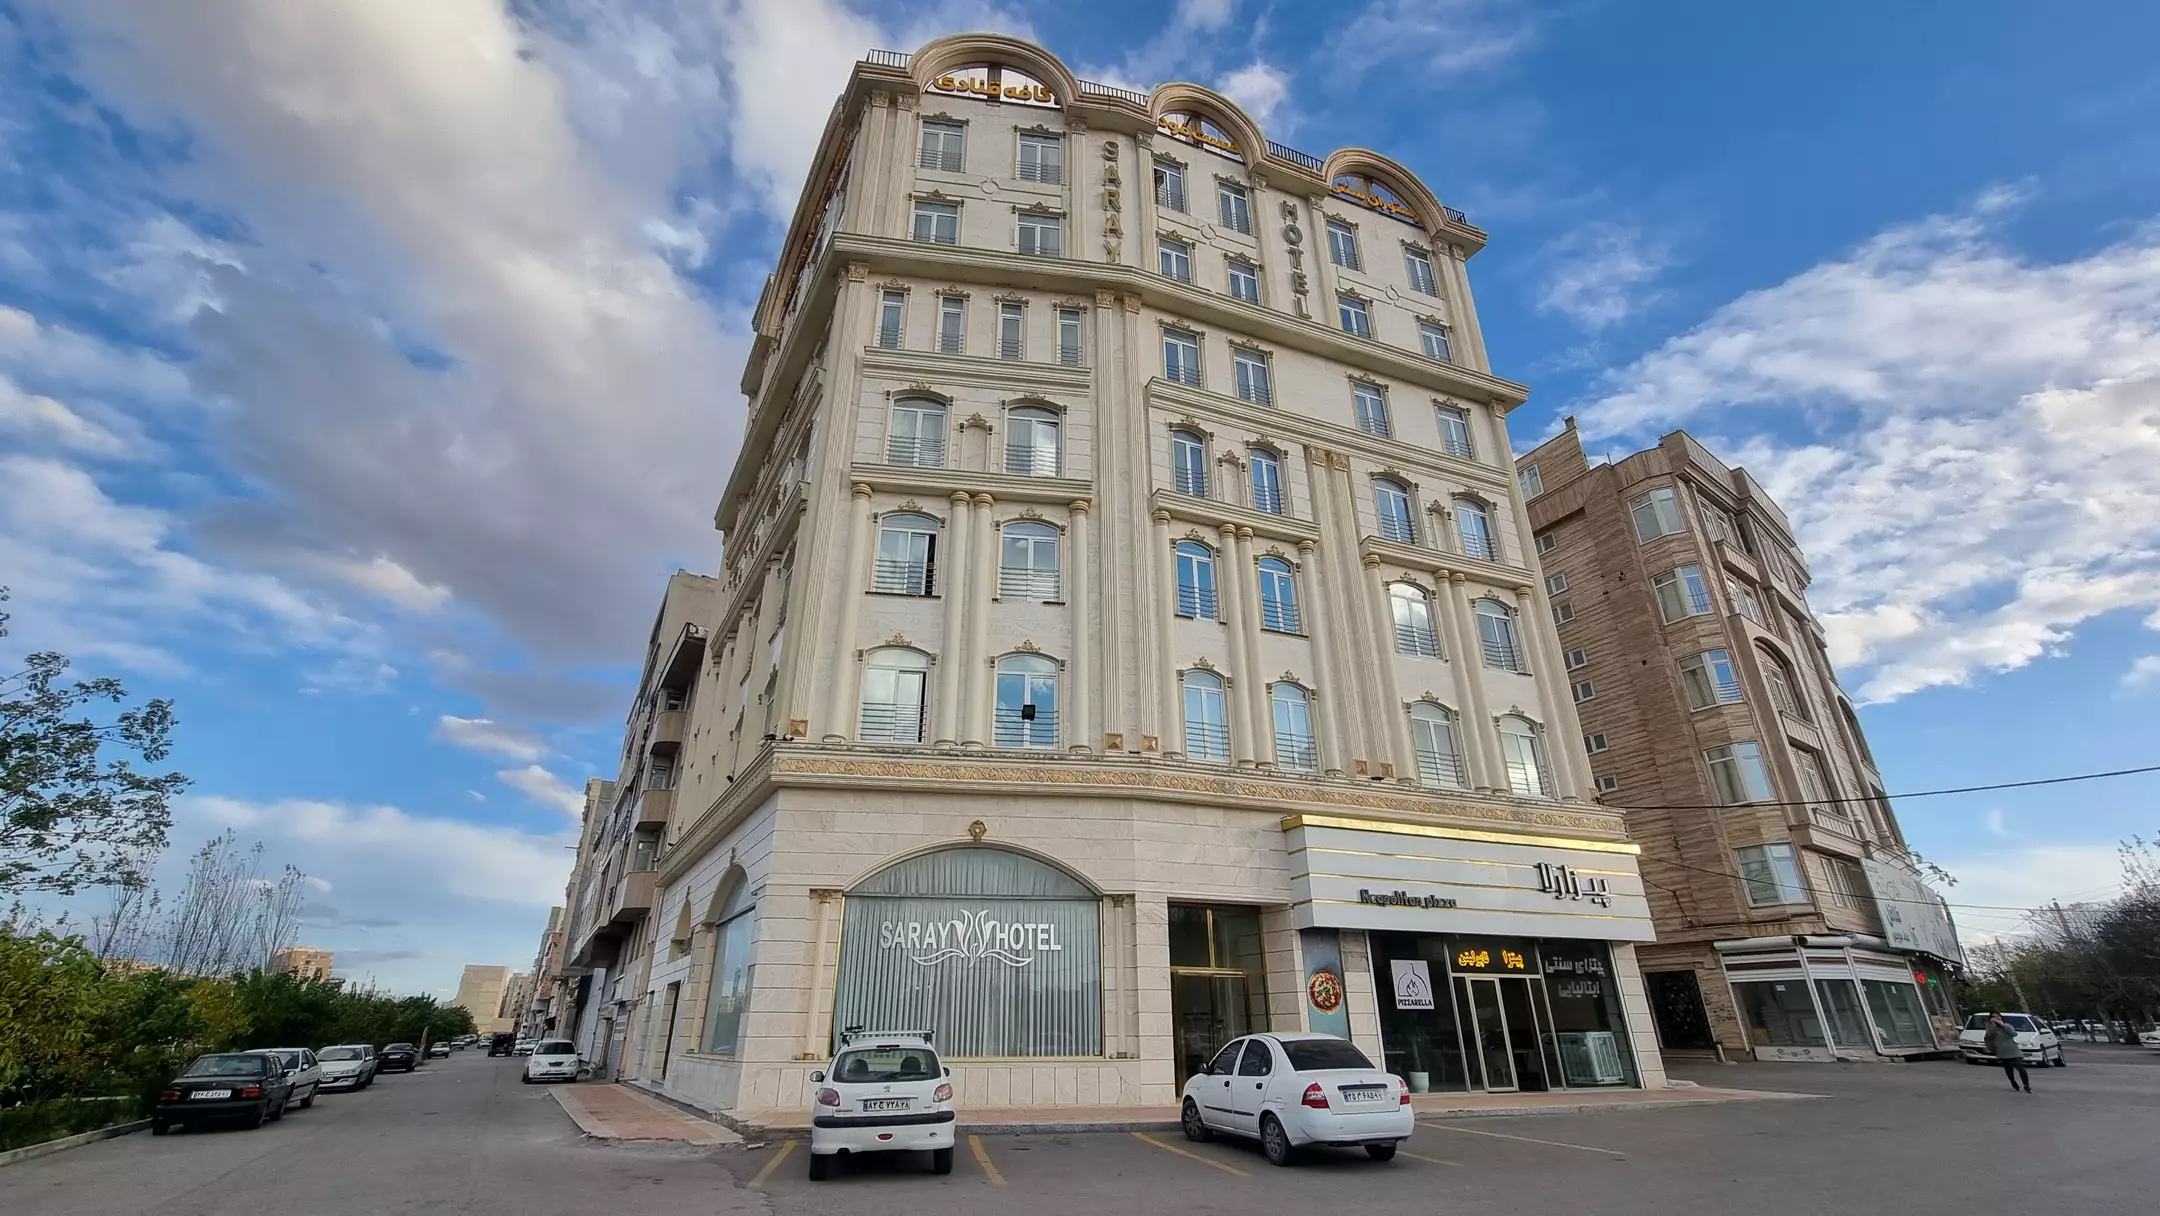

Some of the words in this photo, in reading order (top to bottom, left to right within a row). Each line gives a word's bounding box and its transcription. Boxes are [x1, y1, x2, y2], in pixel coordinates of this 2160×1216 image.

[932, 76, 1001, 98] قنادی
[1004, 84, 1052, 102] کافه
[1102, 140, 1123, 263] SARAY
[1279, 200, 1312, 319] HOTEL
[880, 920, 951, 950] SARAY
[996, 922, 1062, 951] HOTEL
[1398, 998, 1433, 1007] PIZZARELLA
